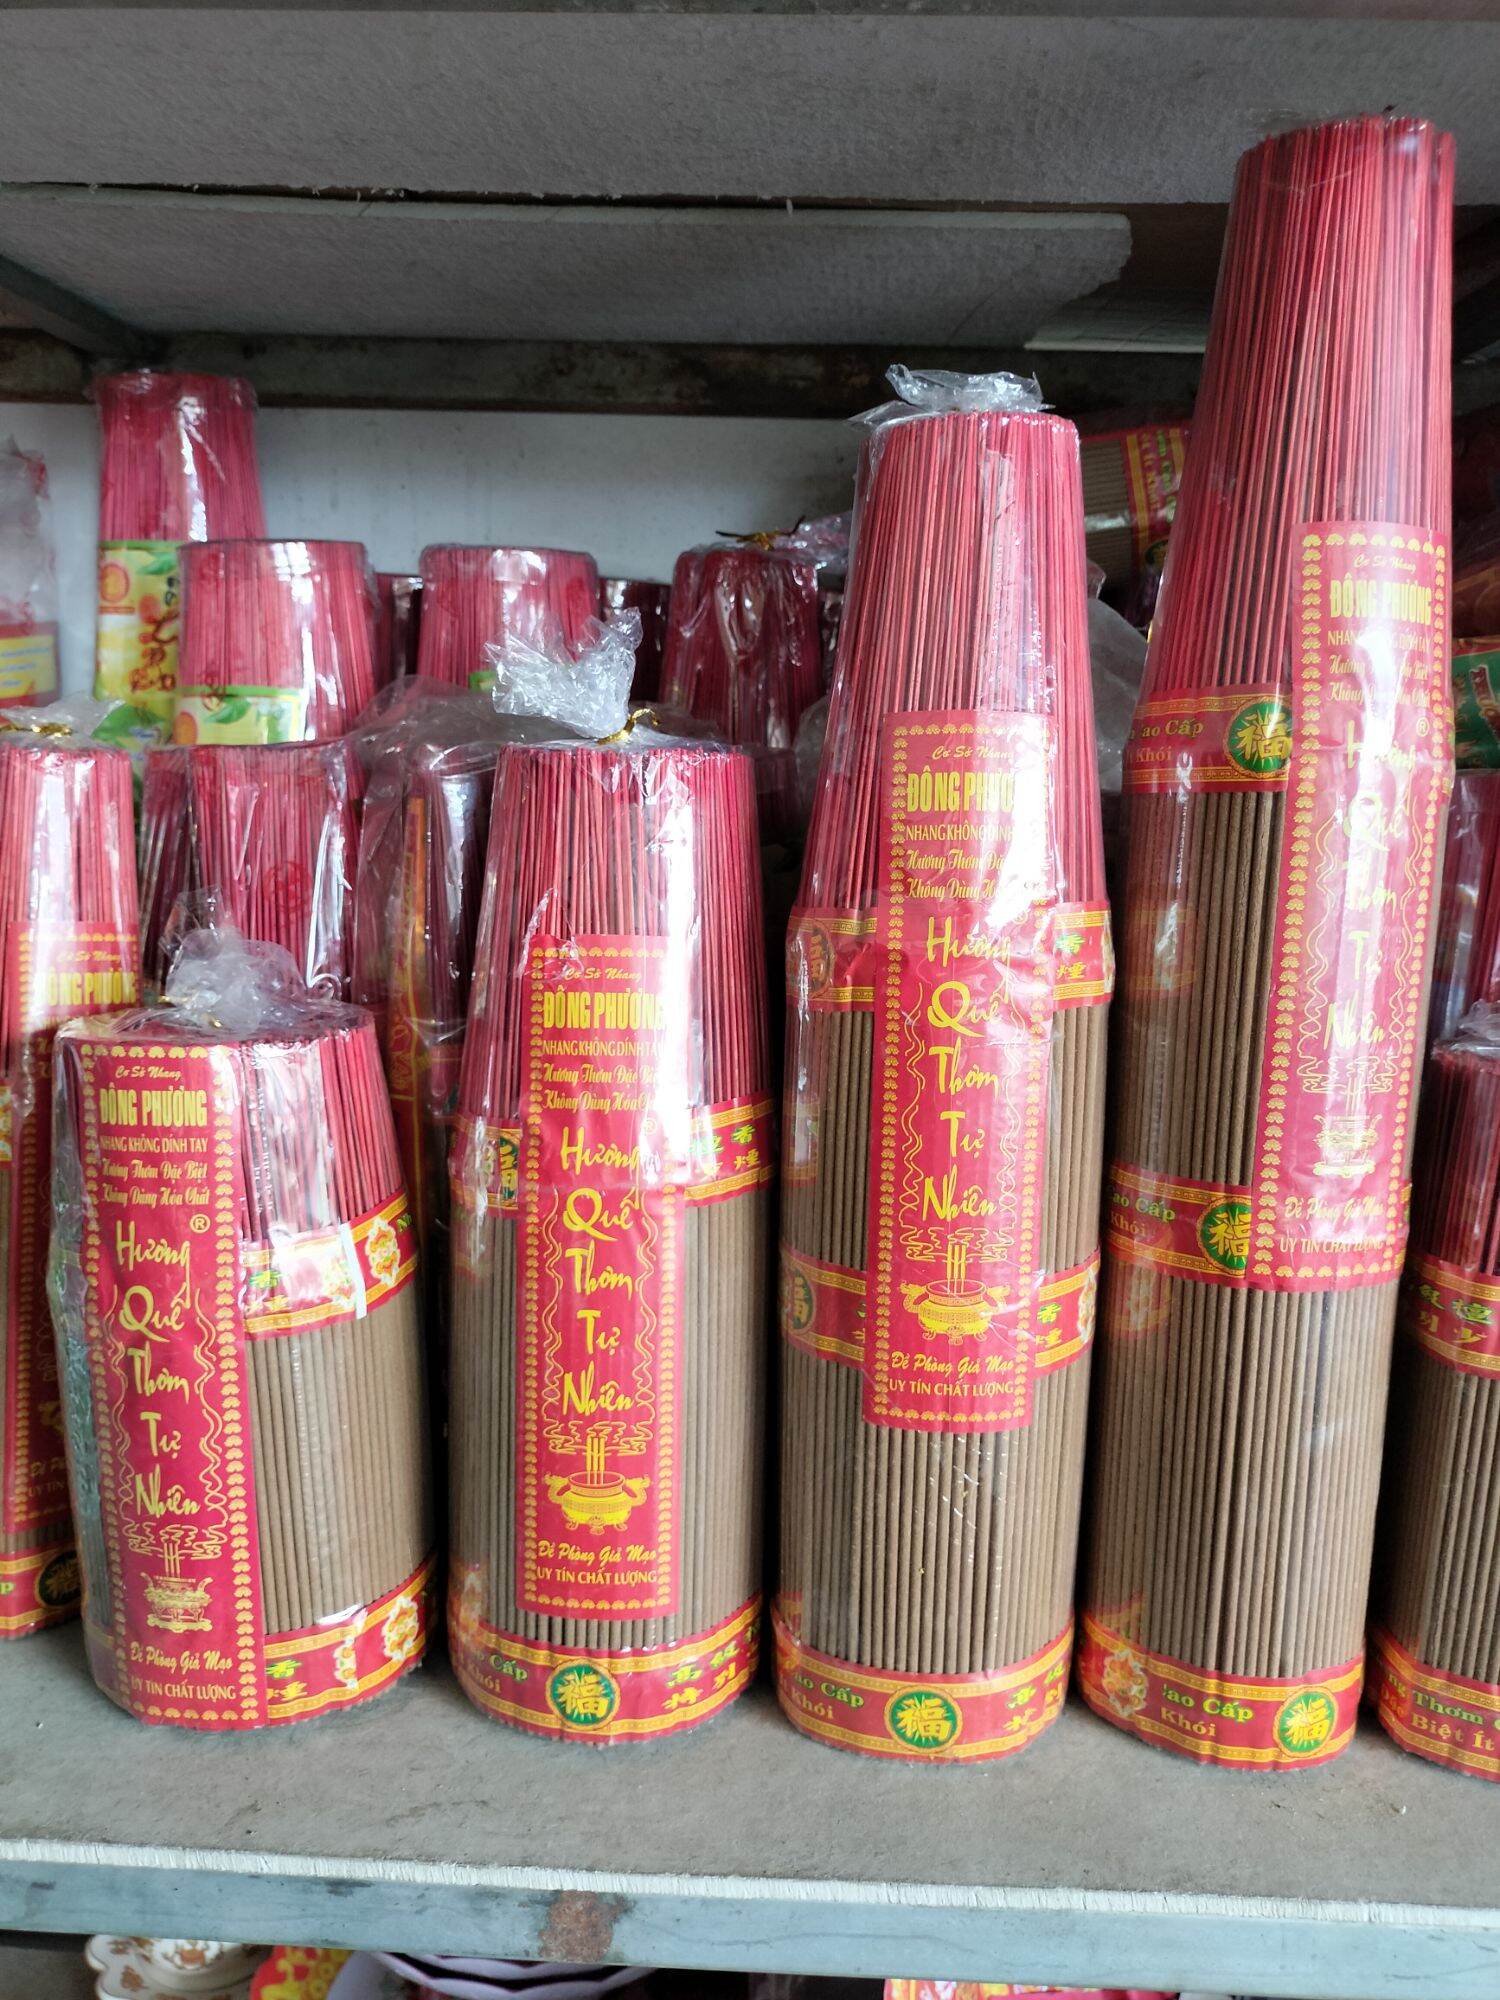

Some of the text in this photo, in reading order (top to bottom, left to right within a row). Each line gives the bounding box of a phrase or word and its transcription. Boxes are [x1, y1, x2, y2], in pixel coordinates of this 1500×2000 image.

[1330, 572, 1378, 619] ĐÔNG
[1165, 717, 1205, 739] Cấp
[906, 765, 960, 813] ĐÔNG
[906, 824, 946, 841] NHANG
[906, 877, 946, 901] Không
[543, 985, 591, 1029] ĐÔNG
[542, 1039, 578, 1056] NHANG
[578, 1036, 617, 1056] KHÔNG
[581, 1063, 613, 1083] Thơm
[929, 1036, 999, 1099] Thơm
[99, 1082, 208, 1128] ĐÔNG PHƯƠNG
[543, 1089, 579, 1110] Không
[162, 1133, 187, 1153] DÍNH
[189, 1137, 208, 1153] TAY
[940, 1110, 984, 1158] Tự
[560, 1126, 642, 1210] Hương
[923, 1164, 997, 1222] Nhiên
[115, 1220, 191, 1309] Hương
[565, 1239, 633, 1301] Thơm
[577, 1309, 622, 1356] Tự
[127, 1340, 190, 1404] Thơm
[914, 1353, 953, 1377] Phòng
[957, 1354, 982, 1380] Giả
[986, 1355, 1014, 1376] Mạo
[563, 1360, 635, 1416] Nhiên
[889, 1380, 906, 1393] UY
[933, 1378, 969, 1397] CHẤT
[971, 1380, 1014, 1399] LƯỢNG
[140, 1411, 181, 1459] Tự
[135, 1463, 200, 1518] Nhiên
[538, 1539, 657, 1566] Đề Phòng Giả Mạo
[537, 1566, 551, 1580] UY
[578, 1566, 612, 1585] CHẤT
[614, 1568, 657, 1587] LƯỢNG
[203, 1650, 233, 1674] Mạo
[489, 1654, 529, 1682] Cấp
[164, 1679, 194, 1699] CHẤT
[196, 1684, 237, 1703] LƯỢNG
[821, 1682, 864, 1709] Cấp
[1160, 1706, 1216, 1737] Khói
[1202, 1697, 1254, 1724] Cấp
[1412, 1689, 1485, 1725] Thơm
[1411, 1713, 1464, 1742] Biệt
